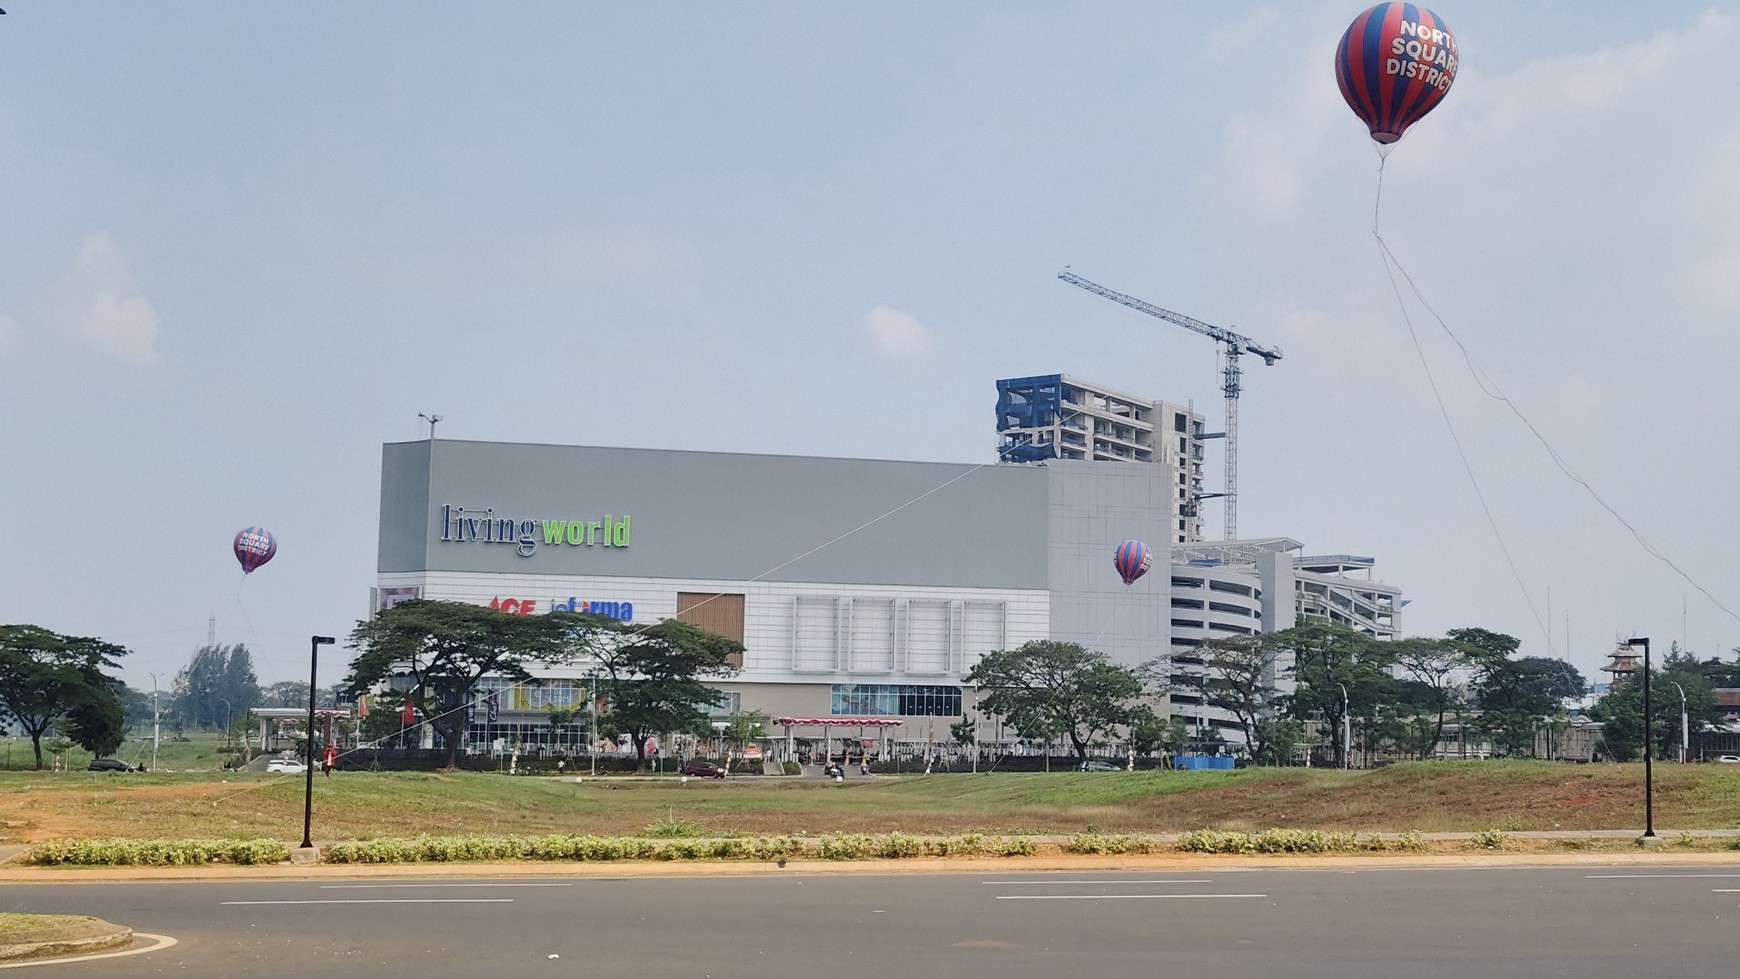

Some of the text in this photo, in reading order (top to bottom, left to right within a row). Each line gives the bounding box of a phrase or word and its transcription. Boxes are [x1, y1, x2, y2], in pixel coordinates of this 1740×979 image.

[1400, 20, 1458, 56] NORTH
[1391, 37, 1458, 77] SQUARE
[1386, 57, 1452, 95] DISTRICT
[239, 537, 270, 551] SQUARE
[242, 532, 269, 544] NORTH
[441, 504, 631, 557] living world
[237, 544, 268, 557] DISTRICT
